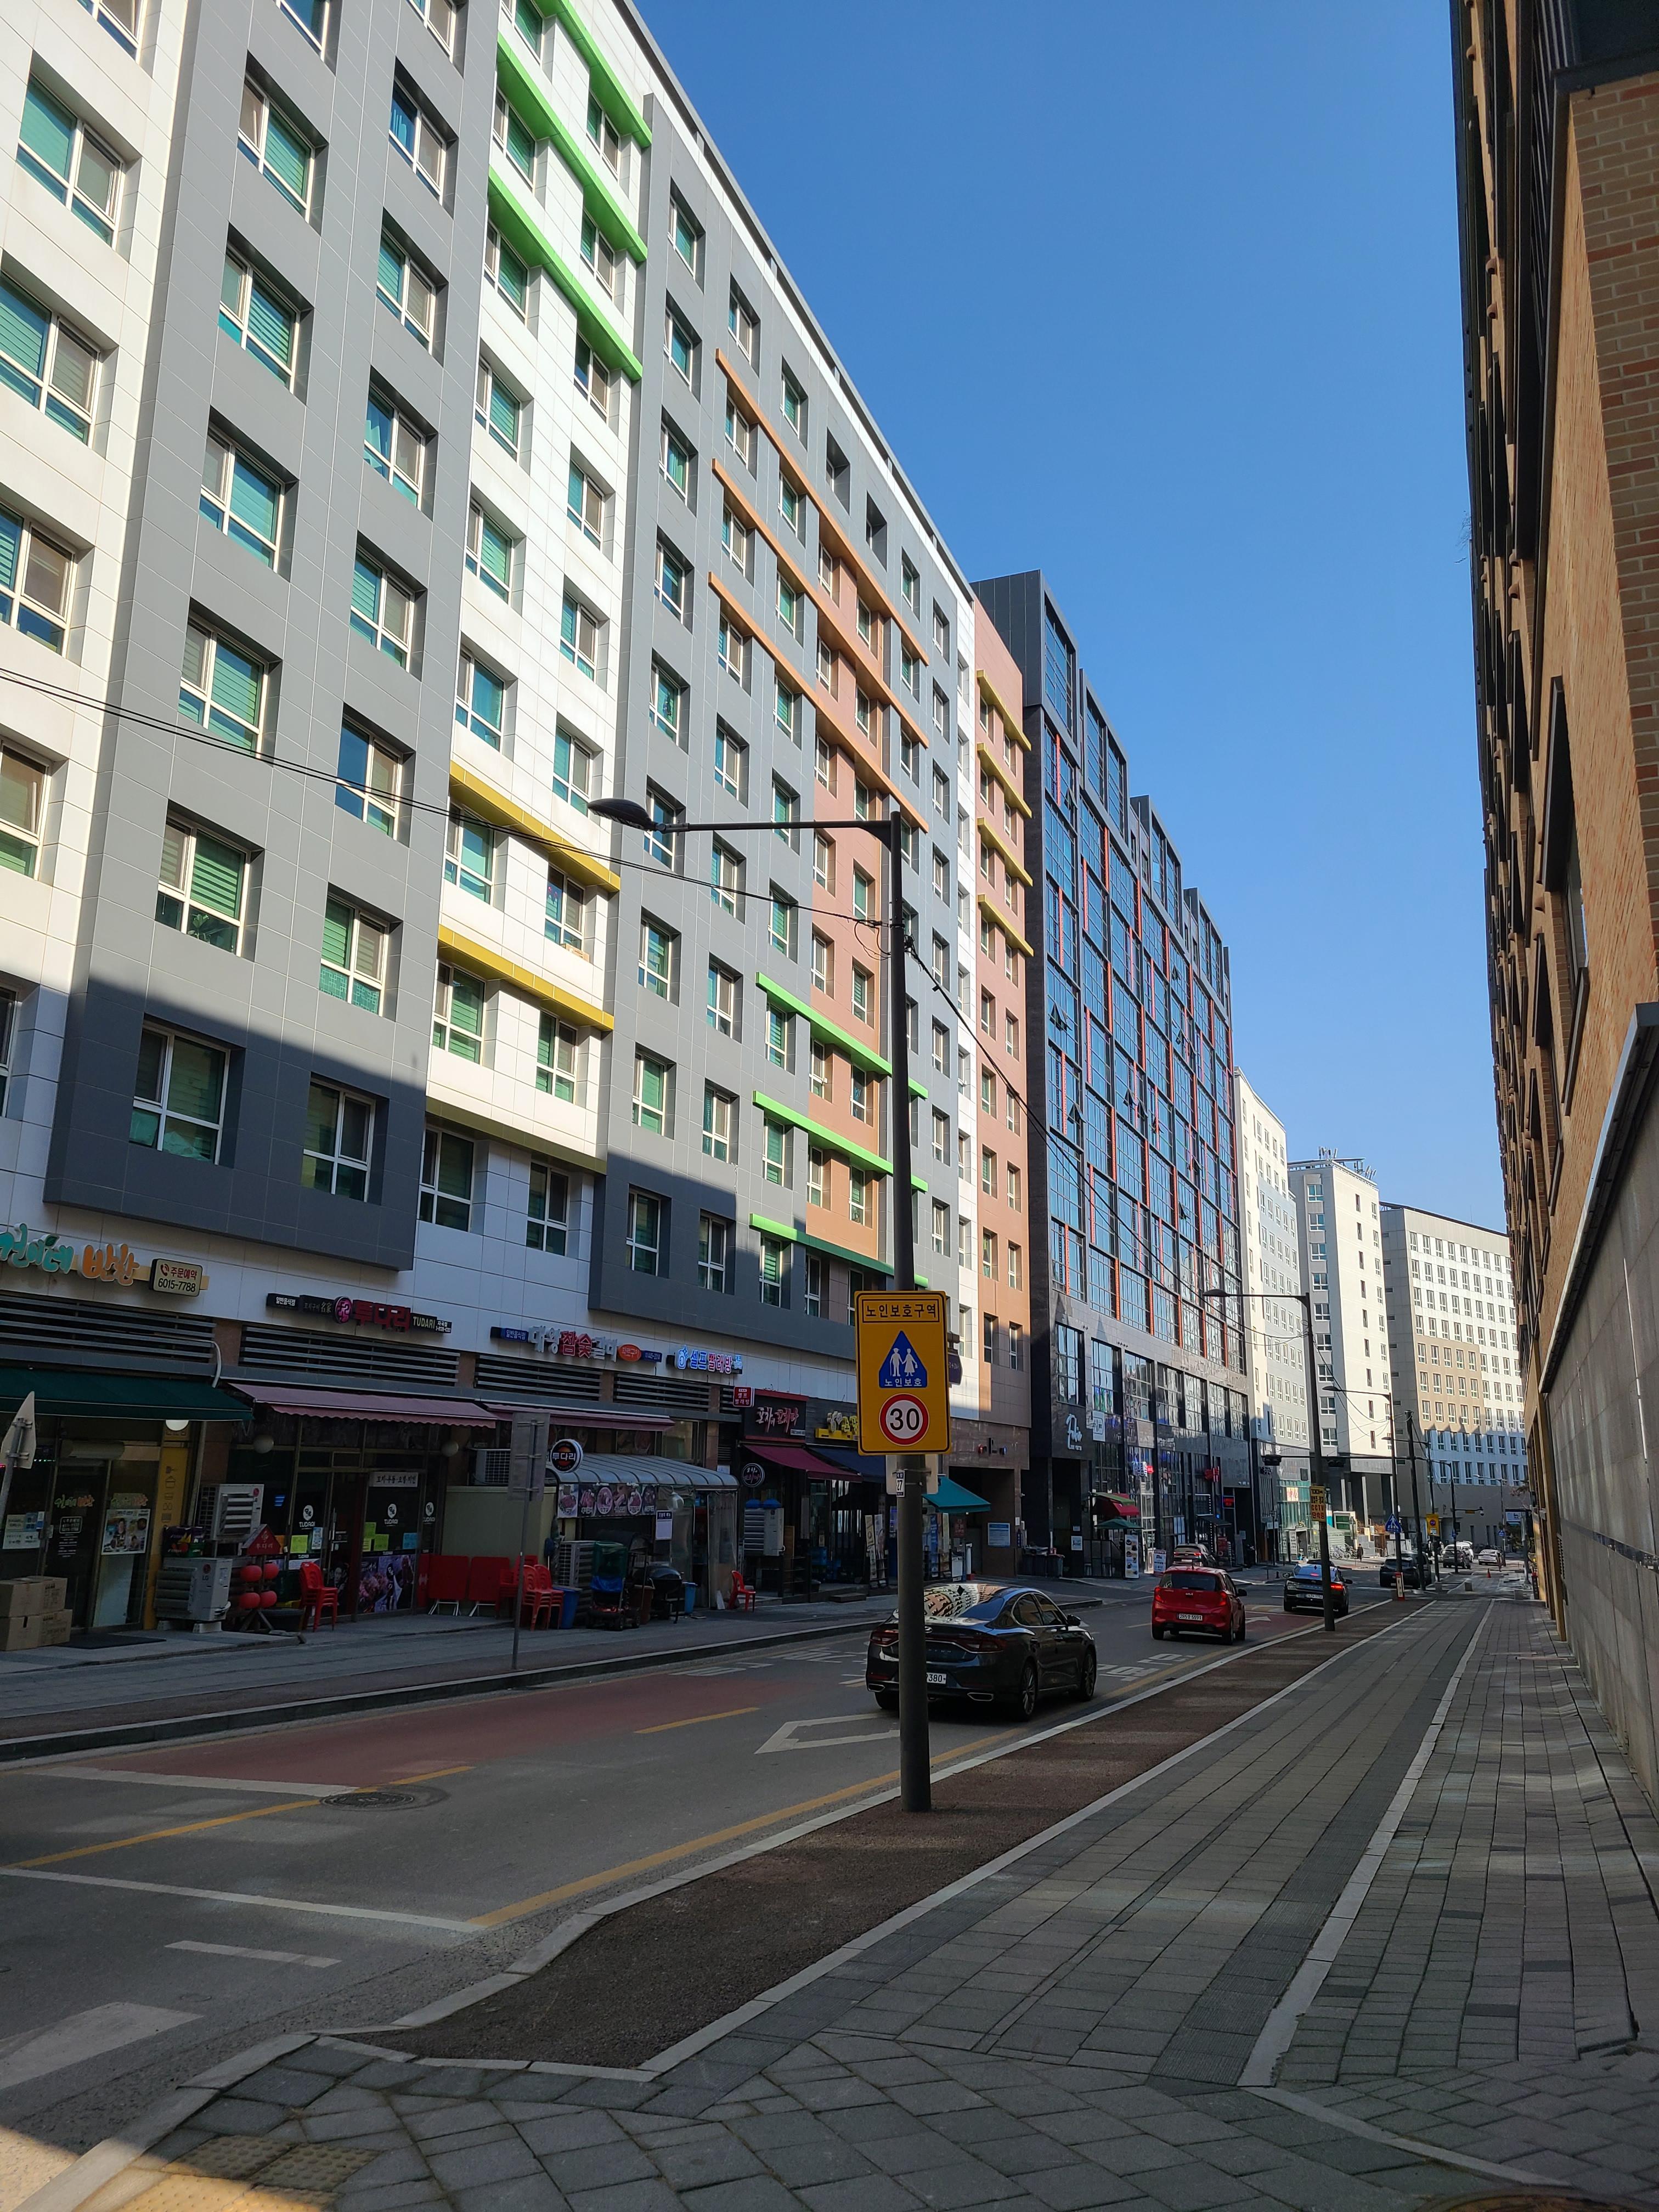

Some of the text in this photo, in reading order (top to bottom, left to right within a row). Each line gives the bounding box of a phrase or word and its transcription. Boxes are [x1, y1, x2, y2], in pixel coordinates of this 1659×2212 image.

[83, 1244, 140, 1285] 반찬
[171, 1267, 197, 1280] 주문예약
[158, 1279, 195, 1292] 6015-7788
[275, 1296, 296, 1307] 일반음식점
[353, 1300, 411, 1332] 투다리
[866, 1303, 936, 1318] 노인보호구역
[413, 1316, 436, 1329] TUDARI
[506, 1329, 527, 1341] 일반음식점
[884, 1378, 922, 1387] 노인보호
[890, 1408, 919, 1431] 30
[552, 1452, 576, 1461] 투다리
[897, 1480, 903, 1491] 27
